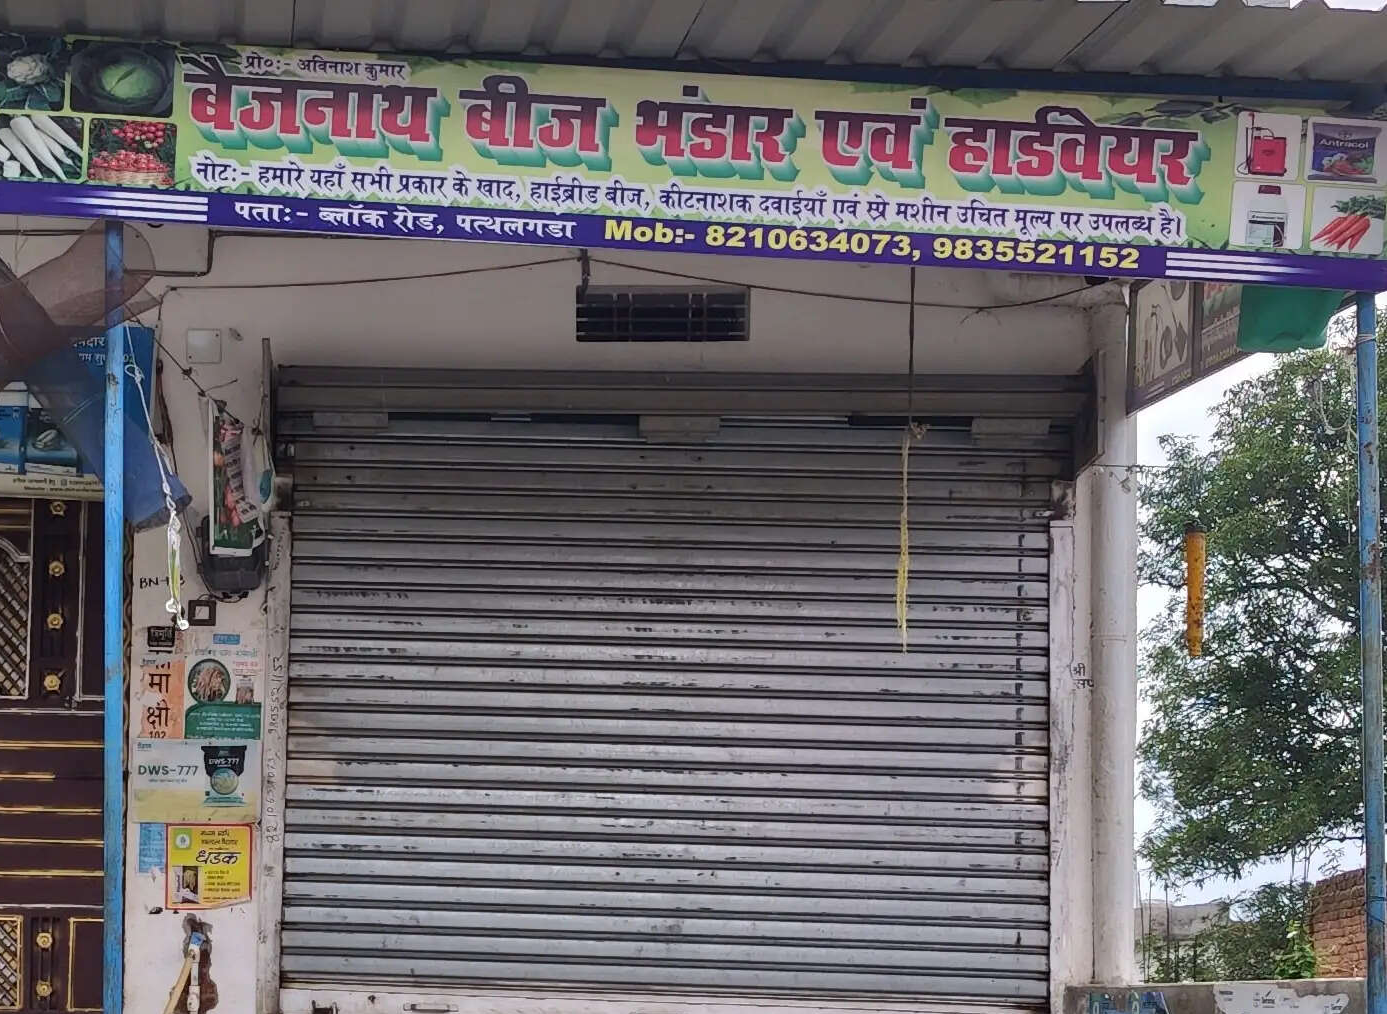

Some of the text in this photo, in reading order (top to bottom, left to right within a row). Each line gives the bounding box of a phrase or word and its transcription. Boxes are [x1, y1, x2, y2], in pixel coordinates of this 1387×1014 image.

[297, 56, 360, 77] अविनाश
[364, 61, 407, 82] कुमार
[177, 53, 440, 145] बैजनाथ
[459, 74, 608, 154] बीज
[635, 85, 795, 164] भंडार
[815, 98, 928, 170] एवं
[1319, 137, 1371, 151] Antracol
[258, 162, 304, 188] हमारे
[309, 162, 344, 188] यहाँ
[351, 166, 393, 191] सभी
[396, 174, 448, 198] प्रकार
[452, 171, 469, 195] के
[660, 182, 753, 213] कीटनाशक
[831, 193, 859, 223] एवं
[896, 201, 948, 226] मशीन
[957, 203, 1007, 228] उचित
[1014, 209, 1052, 240] मूल्य
[1059, 215, 1084, 235] पर
[1089, 212, 1154, 236] उपलब्ध
[932, 237, 1140, 270] 9835521152
[137, 764, 199, 776] DWS-777
